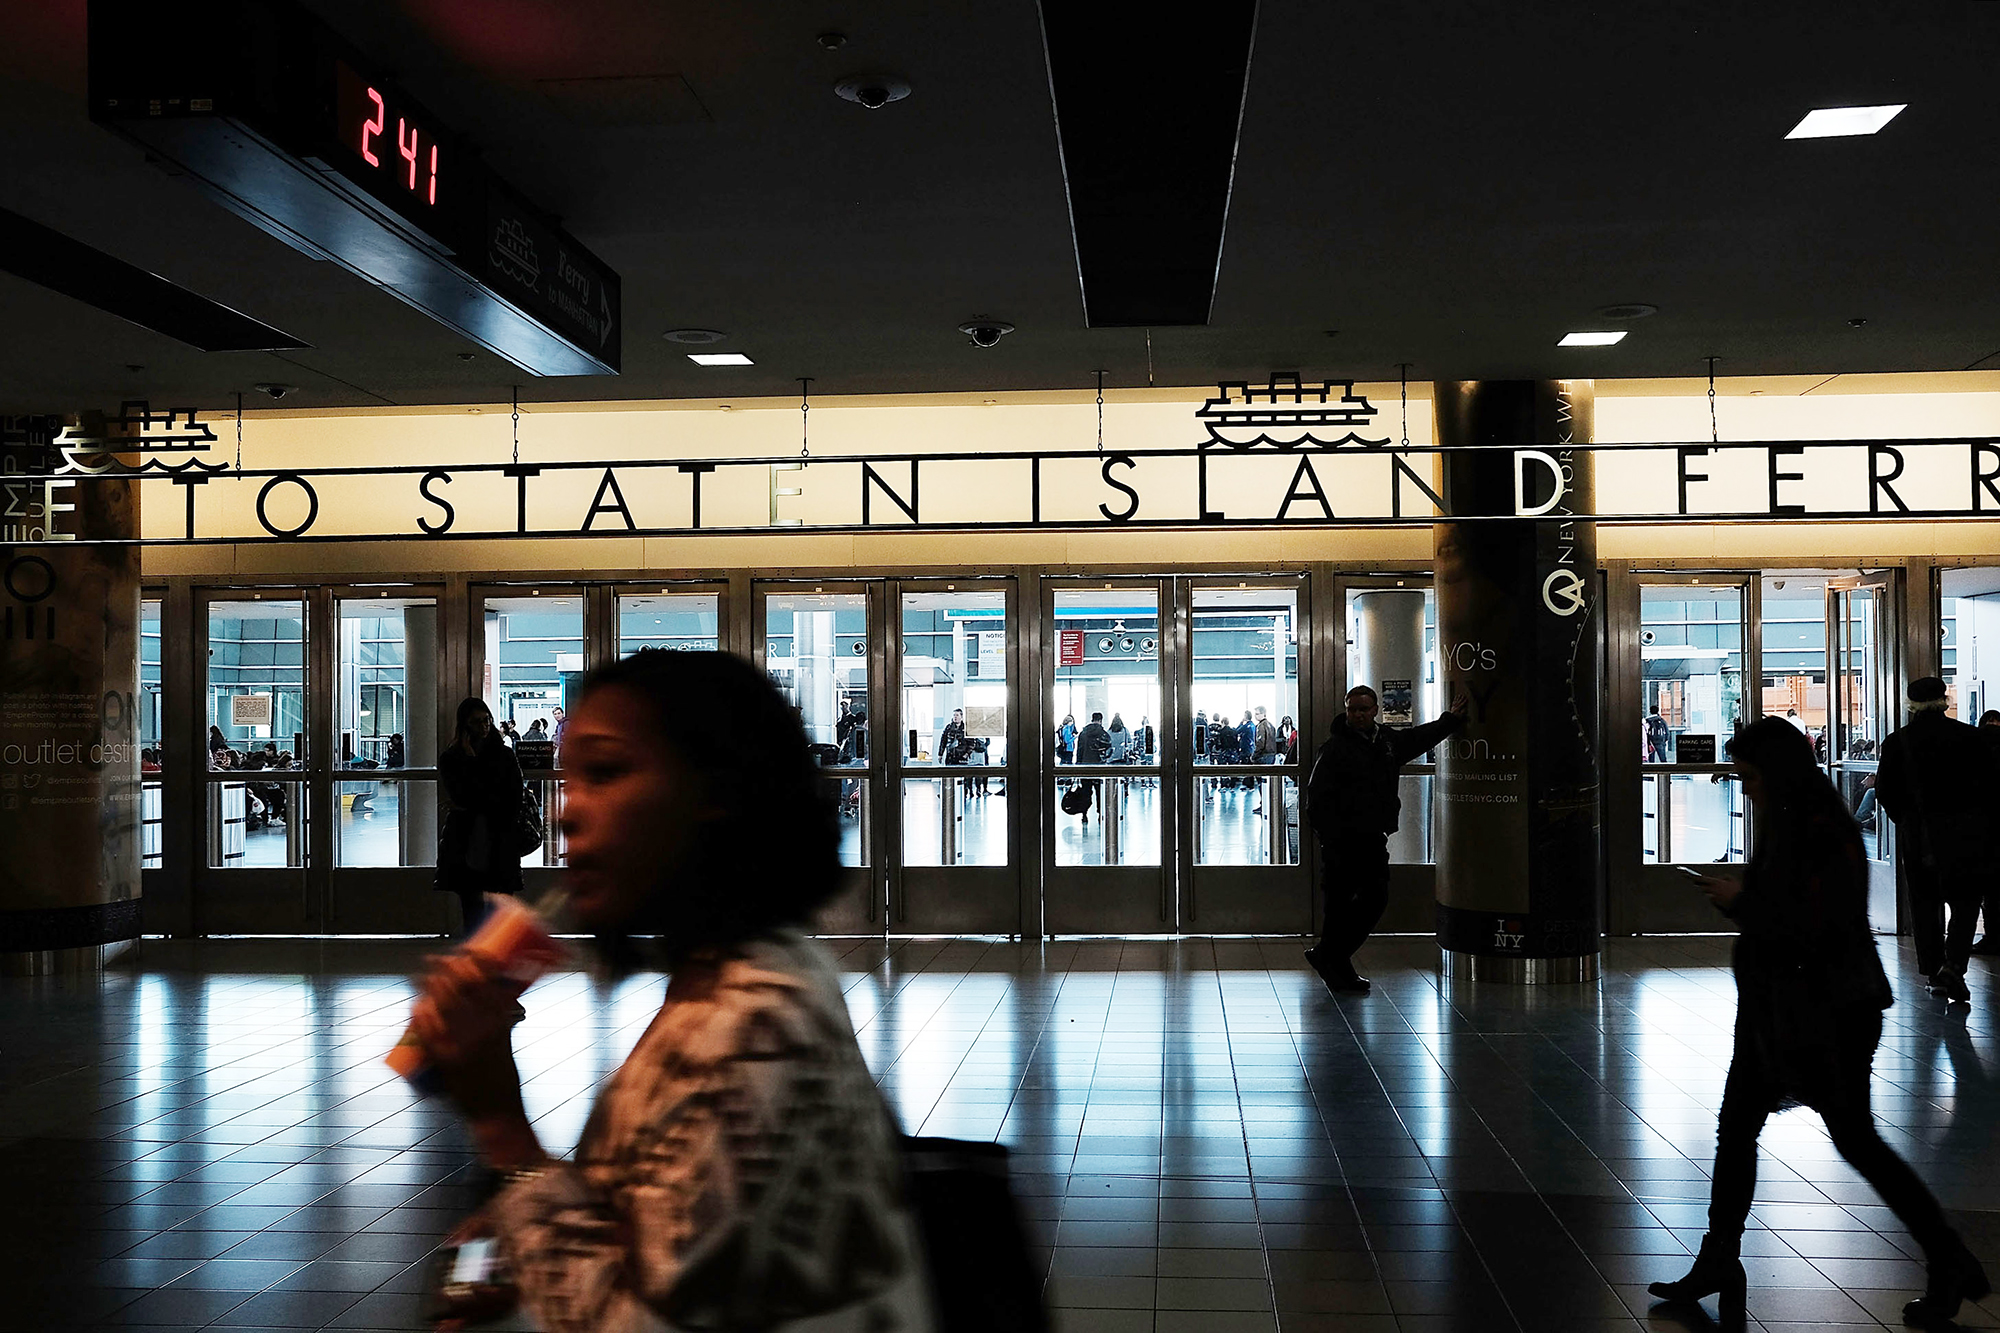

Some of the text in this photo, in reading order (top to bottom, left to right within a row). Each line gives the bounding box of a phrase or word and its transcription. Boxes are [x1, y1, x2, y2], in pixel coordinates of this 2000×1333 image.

[558, 249, 590, 306] Ferry
[548, 283, 598, 336] to MANHATTAN
[1559, 431, 1574, 495] YORK
[172, 474, 319, 540] TO
[416, 458, 918, 536] STATEN
[1031, 448, 1566, 525] ISLAND
[1557, 506, 1575, 565] NEW
[3, 738, 83, 765] outlet
[1464, 773, 1497, 782] MAILING
[1498, 773, 1518, 781] LIST
[1494, 933, 1525, 949] NY
[1497, 918, 1505, 933] I
